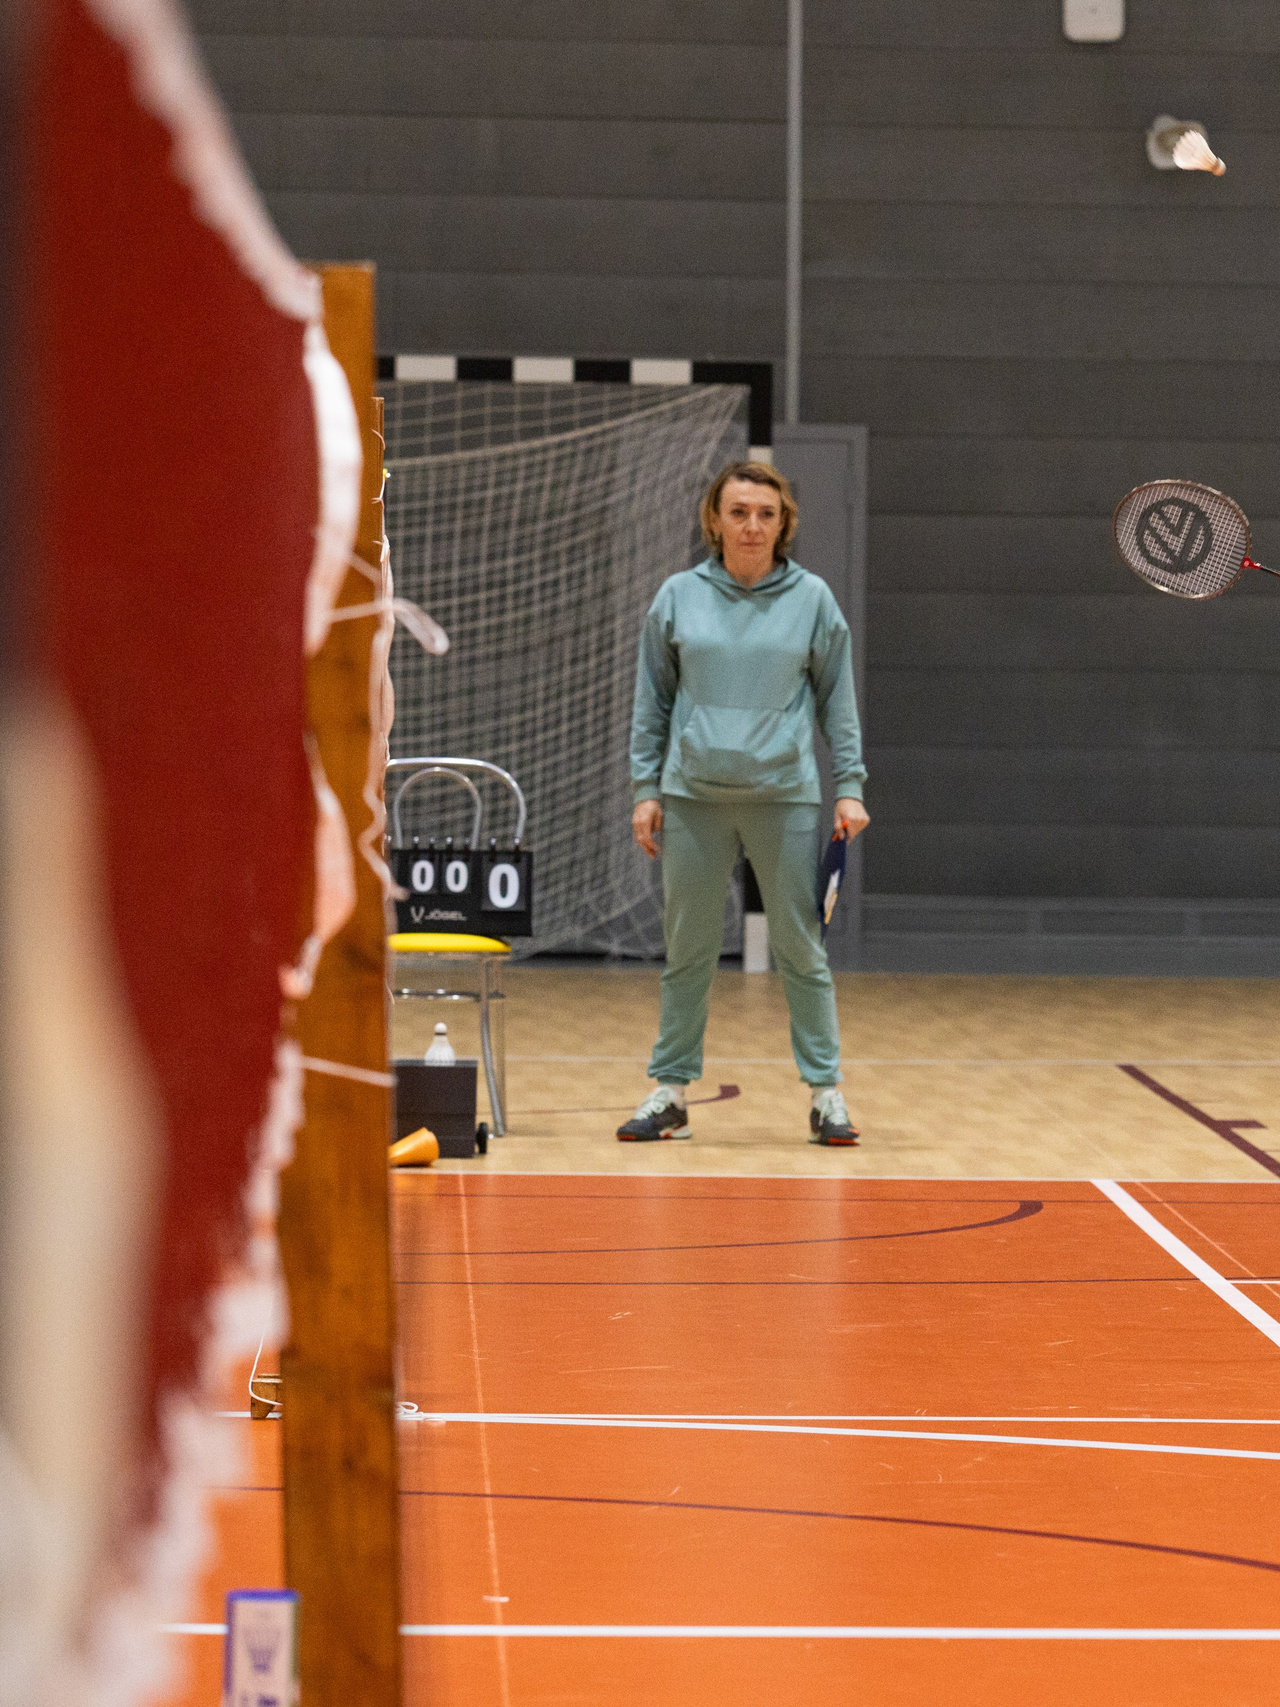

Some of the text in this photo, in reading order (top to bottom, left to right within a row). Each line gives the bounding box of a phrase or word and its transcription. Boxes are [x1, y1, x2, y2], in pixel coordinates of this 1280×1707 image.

[412, 860, 519, 908] 0 0 0
